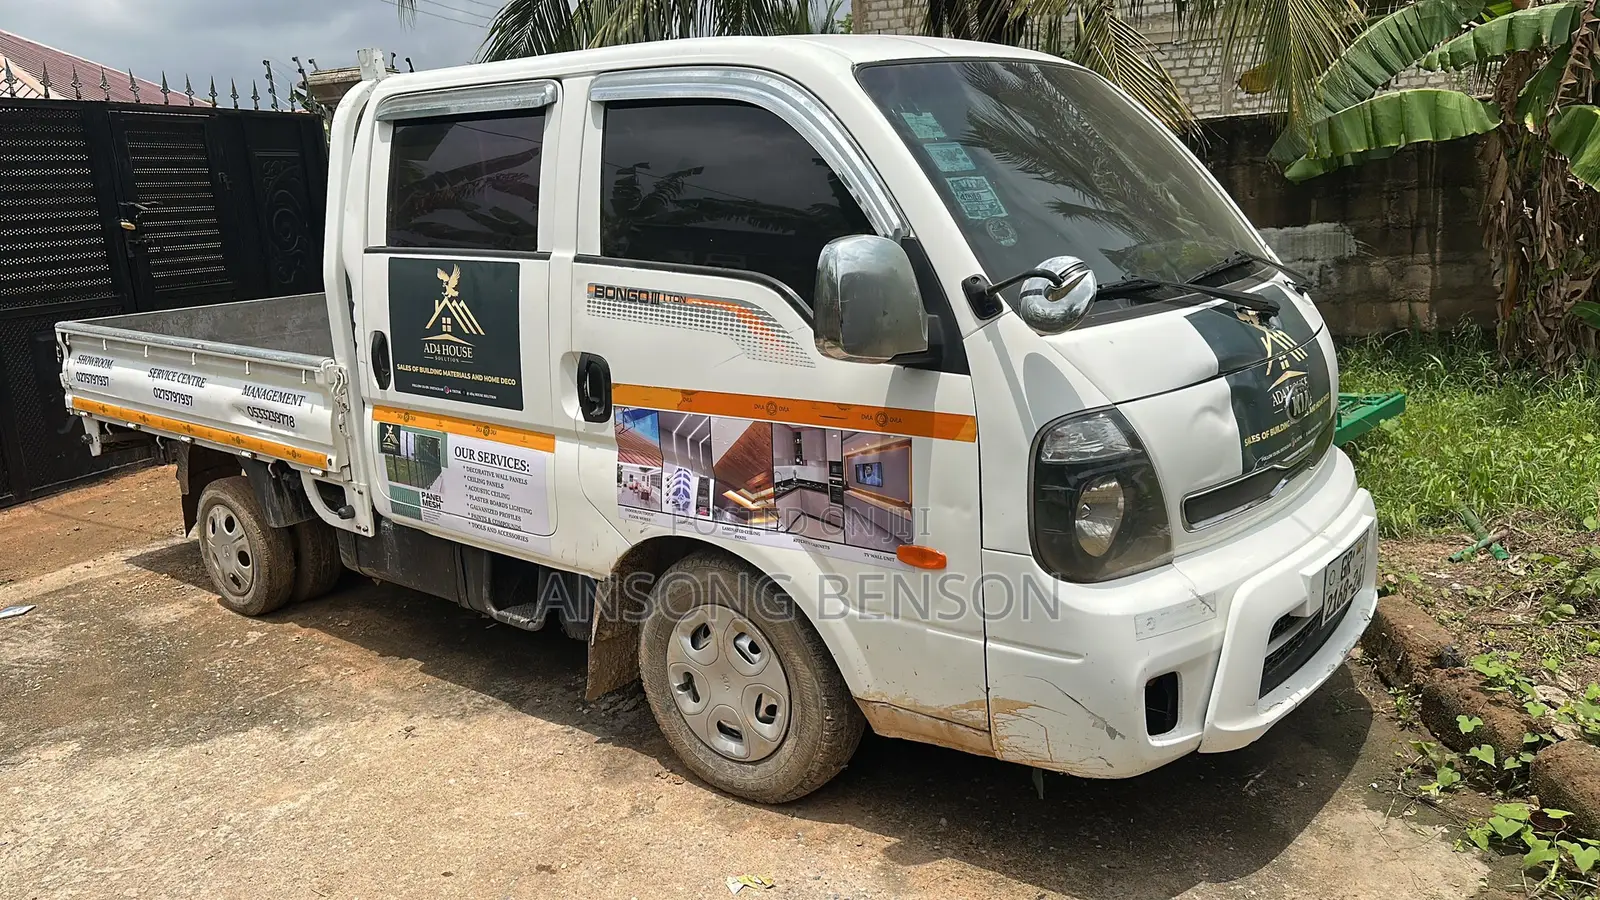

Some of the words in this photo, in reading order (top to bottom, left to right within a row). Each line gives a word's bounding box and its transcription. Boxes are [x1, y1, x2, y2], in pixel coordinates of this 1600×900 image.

[595, 285, 648, 303] BONGO
[434, 355, 459, 363] SOLUTION
[442, 344, 473, 359] HOUSE
[77, 354, 113, 369] SHOWROOM
[148, 367, 176, 382] SERVICE
[176, 373, 207, 389] CENTRE
[396, 363, 412, 372] SALES
[412, 365, 420, 373] OF
[420, 366, 443, 376] BUILDING
[443, 369, 471, 380] MATERIALS
[471, 373, 483, 381] AND
[484, 374, 500, 384] HOME
[500, 377, 516, 386] DECO
[153, 387, 193, 407] 0275797937
[241, 384, 305, 407] MANAGEMENT
[247, 405, 295, 428] 0533239778
[1244, 433, 1261, 447] SALES
[1261, 430, 1270, 440] OF
[454, 446, 475, 461] OUR
[477, 450, 530, 472] SERVICES:
[466, 465, 494, 478] DECORATIVE
[495, 472, 508, 481] WALL
[509, 475, 528, 486] PANELS
[467, 475, 486, 485] CEILING
[486, 480, 504, 490] PANELS
[421, 491, 444, 503] PANEL
[468, 485, 490, 496] ACOUSTIC
[490, 490, 510, 500] CEILING
[422, 499, 441, 509] MESH
[469, 494, 489, 505] PLASTER
[489, 499, 508, 509] BOARDS
[509, 504, 533, 515] LIGHTING
[470, 504, 498, 516] GALVANIZED
[499, 511, 521, 522] PROFILES
[471, 512, 487, 522] PAINTS
[471, 521, 486, 531] TOOLS
[487, 526, 497, 534] AND
[497, 530, 529, 543] ACCESSORIES
